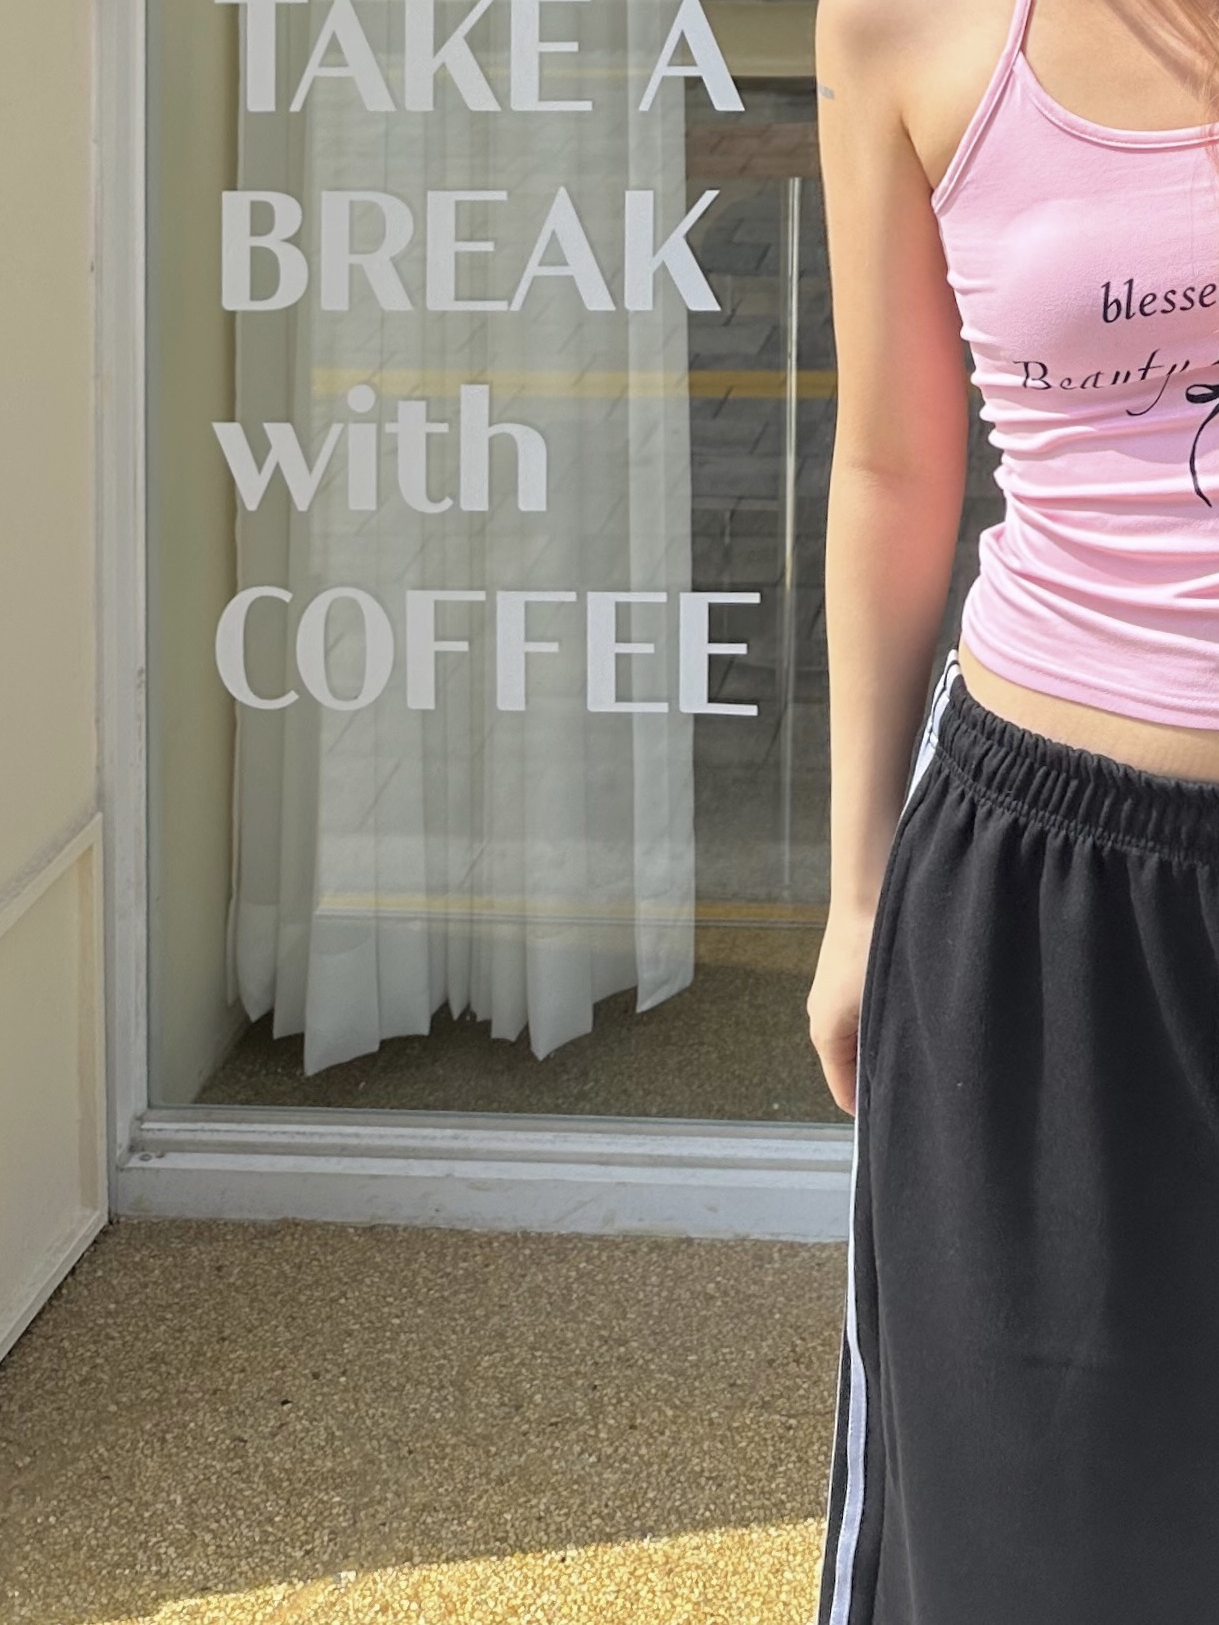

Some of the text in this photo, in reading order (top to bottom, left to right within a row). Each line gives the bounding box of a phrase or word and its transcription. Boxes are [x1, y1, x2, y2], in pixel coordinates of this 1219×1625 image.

[220, 186, 722, 312] BREAK
[1013, 348, 1190, 417] Beauty
[211, 383, 548, 514] with
[214, 585, 761, 717] COFFEE
